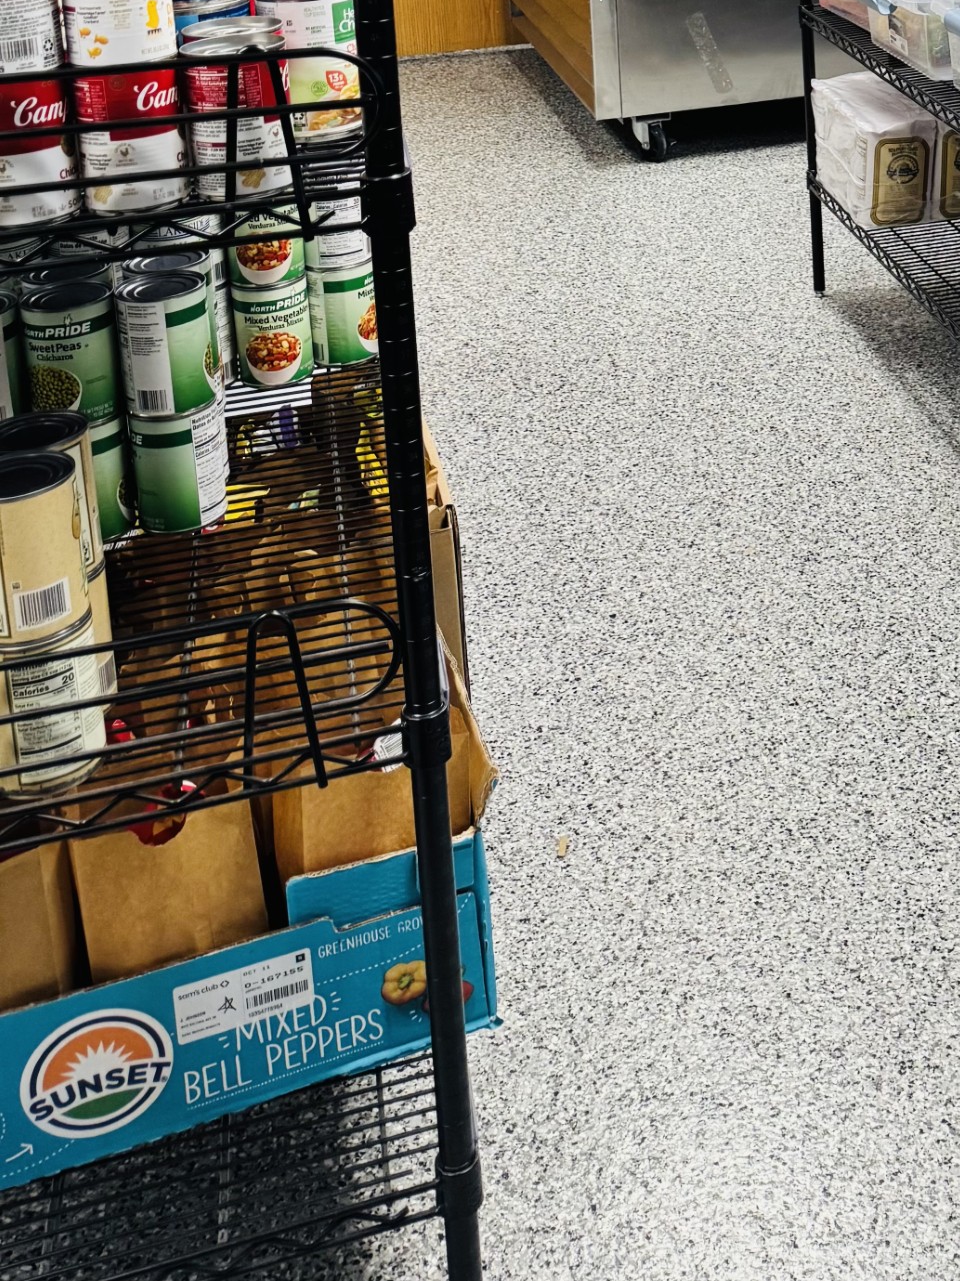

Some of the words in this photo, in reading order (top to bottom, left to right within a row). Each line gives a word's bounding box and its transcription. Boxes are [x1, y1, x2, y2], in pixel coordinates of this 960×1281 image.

[250, 304, 276, 313] NORTH
[276, 291, 306, 310] PRIDE
[243, 315, 270, 325] Mixed
[257, 323, 285, 332] Verduras
[45, 321, 91, 338] PRIDE
[28, 341, 56, 352] Sweet
[56, 341, 82, 351] Peas
[61, 672, 75, 685] 20
[317, 925, 392, 959] GREENHOUSE
[177, 988, 201, 1001] sam's
[201, 984, 219, 994] club
[235, 993, 327, 1052] MIXED
[183, 1054, 252, 1106] BELL
[266, 1008, 384, 1076] PEPPERS
[29, 1061, 171, 1122] SUNSET
